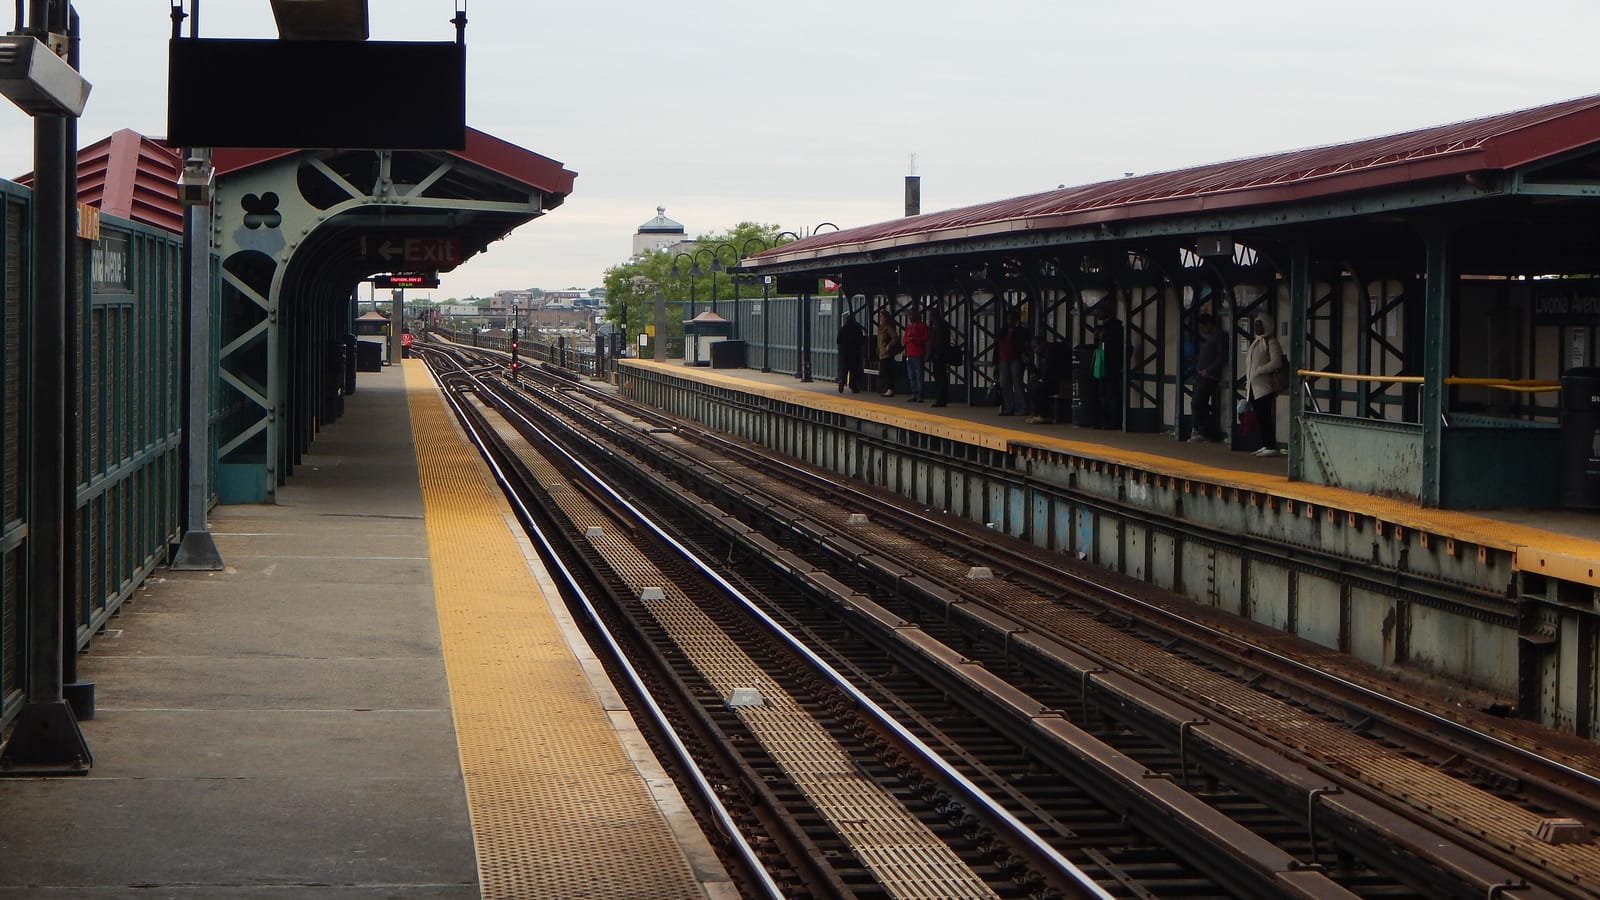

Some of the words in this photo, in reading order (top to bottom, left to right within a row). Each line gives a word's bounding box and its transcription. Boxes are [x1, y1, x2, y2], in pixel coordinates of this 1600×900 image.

[404, 239, 455, 261] Exit
[1535, 290, 1568, 313] Livonia
[1571, 290, 1600, 313] Avenu
